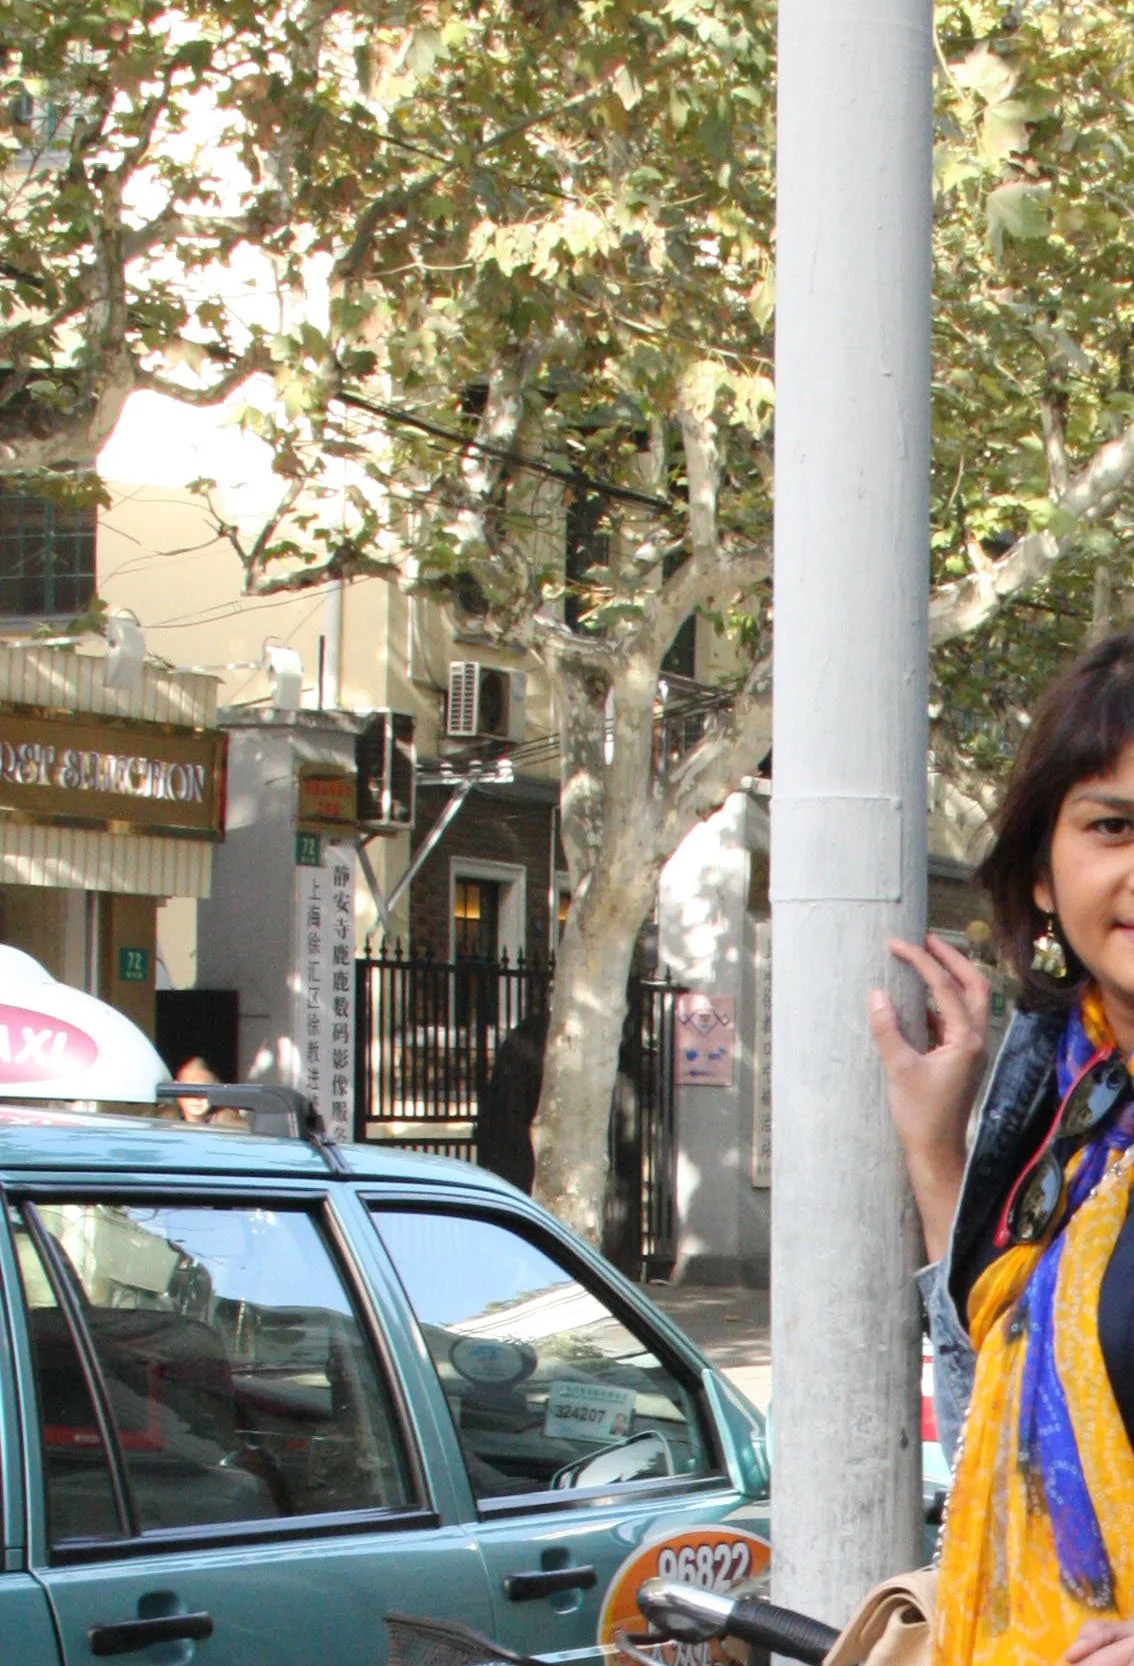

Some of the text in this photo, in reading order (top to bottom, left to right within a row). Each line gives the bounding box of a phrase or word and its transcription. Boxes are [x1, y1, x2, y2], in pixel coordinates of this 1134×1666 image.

[59, 749, 205, 803] SELECTION
[303, 838, 316, 856] 72
[127, 951, 142, 970] 72
[555, 1404, 607, 1424] 324207
